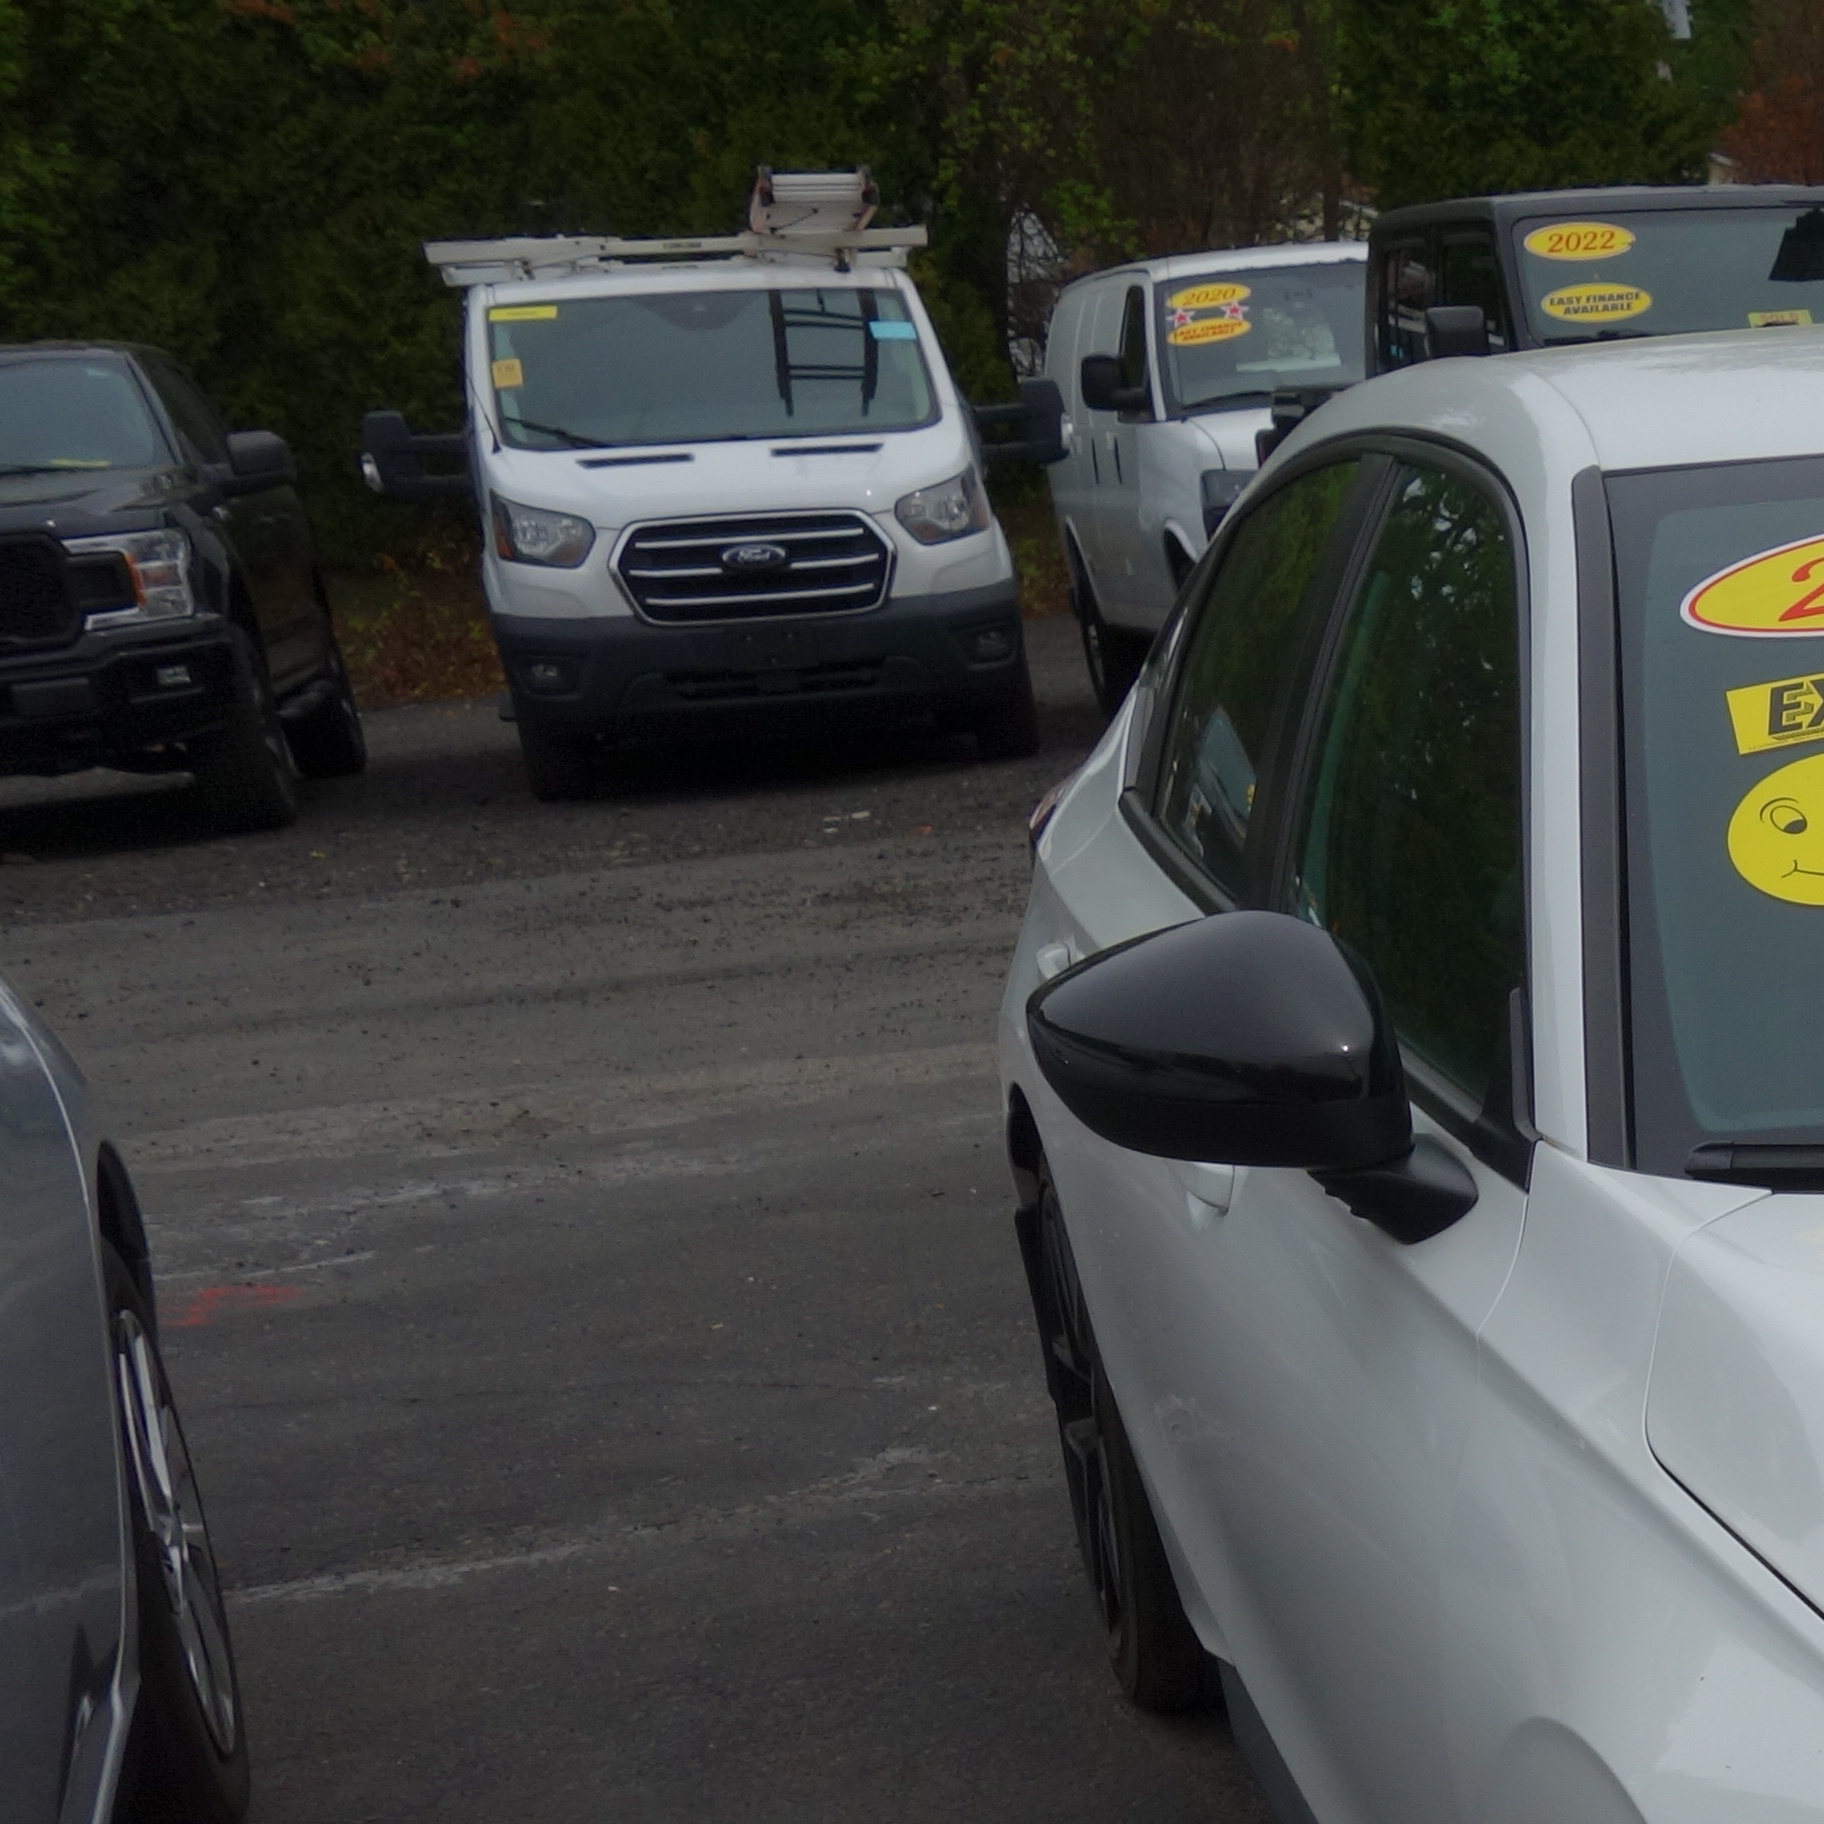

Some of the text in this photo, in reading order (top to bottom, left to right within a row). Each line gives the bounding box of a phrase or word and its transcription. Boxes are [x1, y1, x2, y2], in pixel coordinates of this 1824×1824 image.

[1547, 229, 1616, 253] 2022
[1182, 287, 1236, 307] 2020
[1550, 291, 1641, 307] EASY FINANCE
[1563, 302, 1633, 316] AVAILABLE
